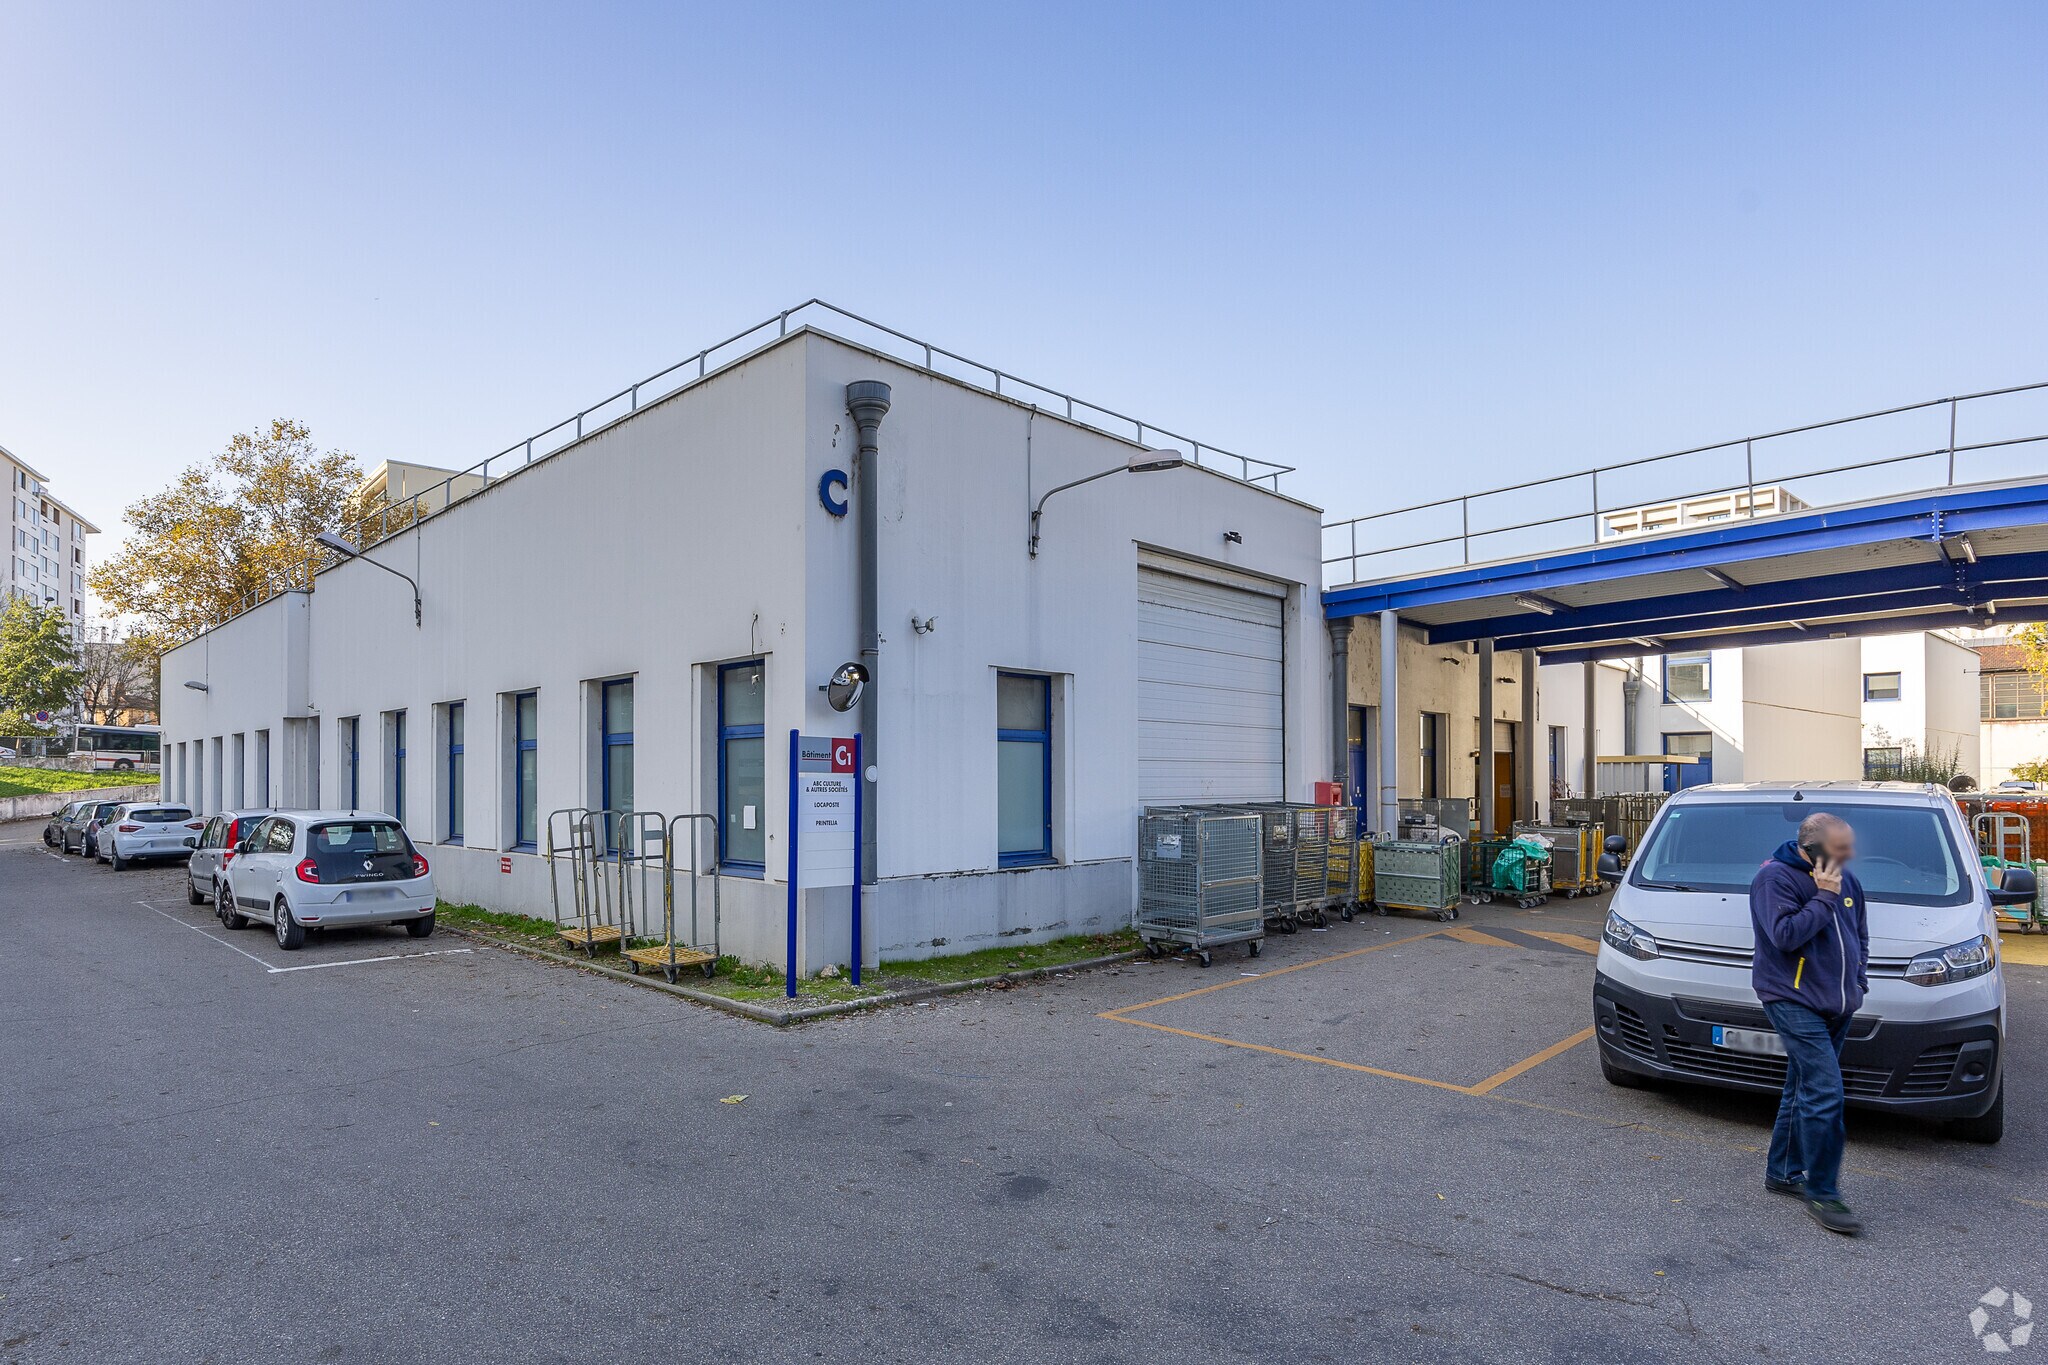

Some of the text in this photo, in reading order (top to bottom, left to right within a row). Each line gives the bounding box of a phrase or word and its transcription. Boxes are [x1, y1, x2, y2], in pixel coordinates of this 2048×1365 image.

[820, 469, 848, 517] C
[801, 745, 852, 766] Bâtiment C1
